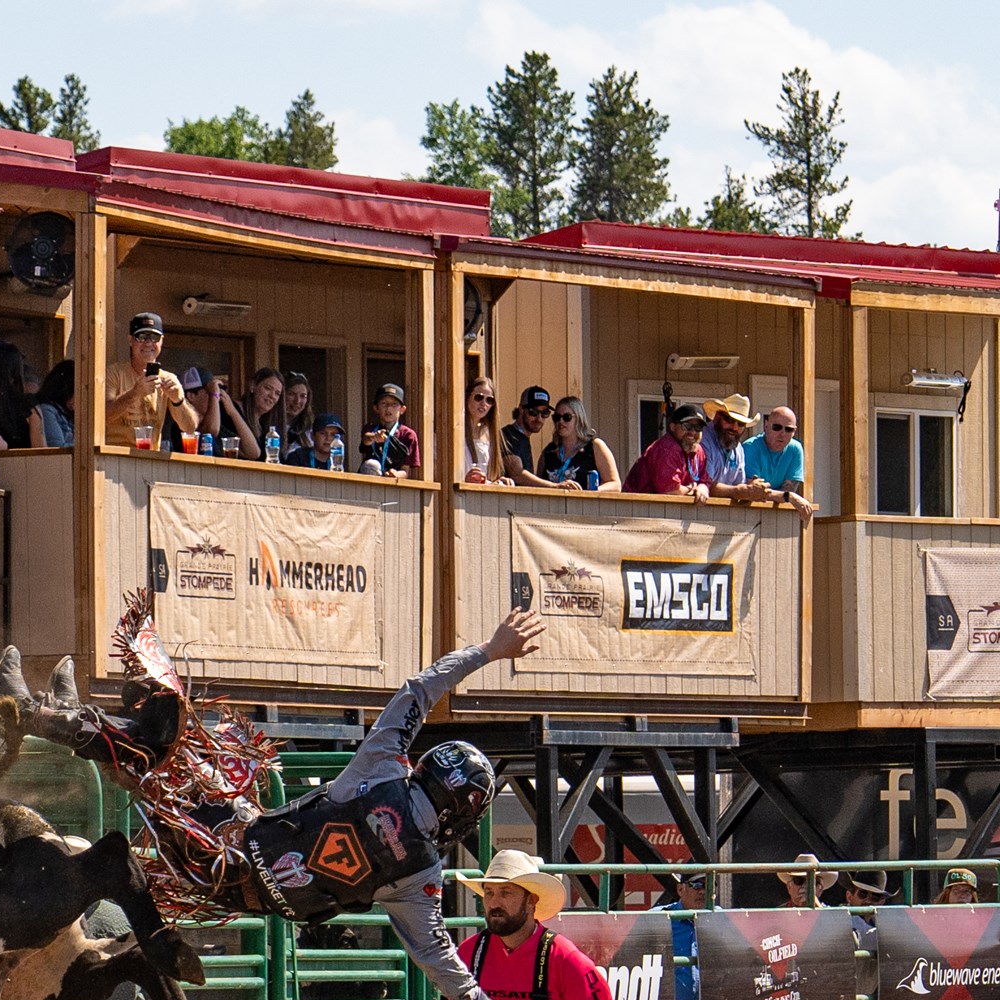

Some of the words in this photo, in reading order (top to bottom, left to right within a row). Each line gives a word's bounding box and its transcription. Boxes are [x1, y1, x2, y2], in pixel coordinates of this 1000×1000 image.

[180, 575, 233, 591] STOMPEDE
[544, 595, 600, 609] STOMPEDE
[626, 570, 729, 620] EMSCO
[938, 614, 953, 627] SA
[972, 632, 1000, 645] STO
[768, 943, 798, 963] OILFIELD
[929, 962, 980, 986] bluewave
